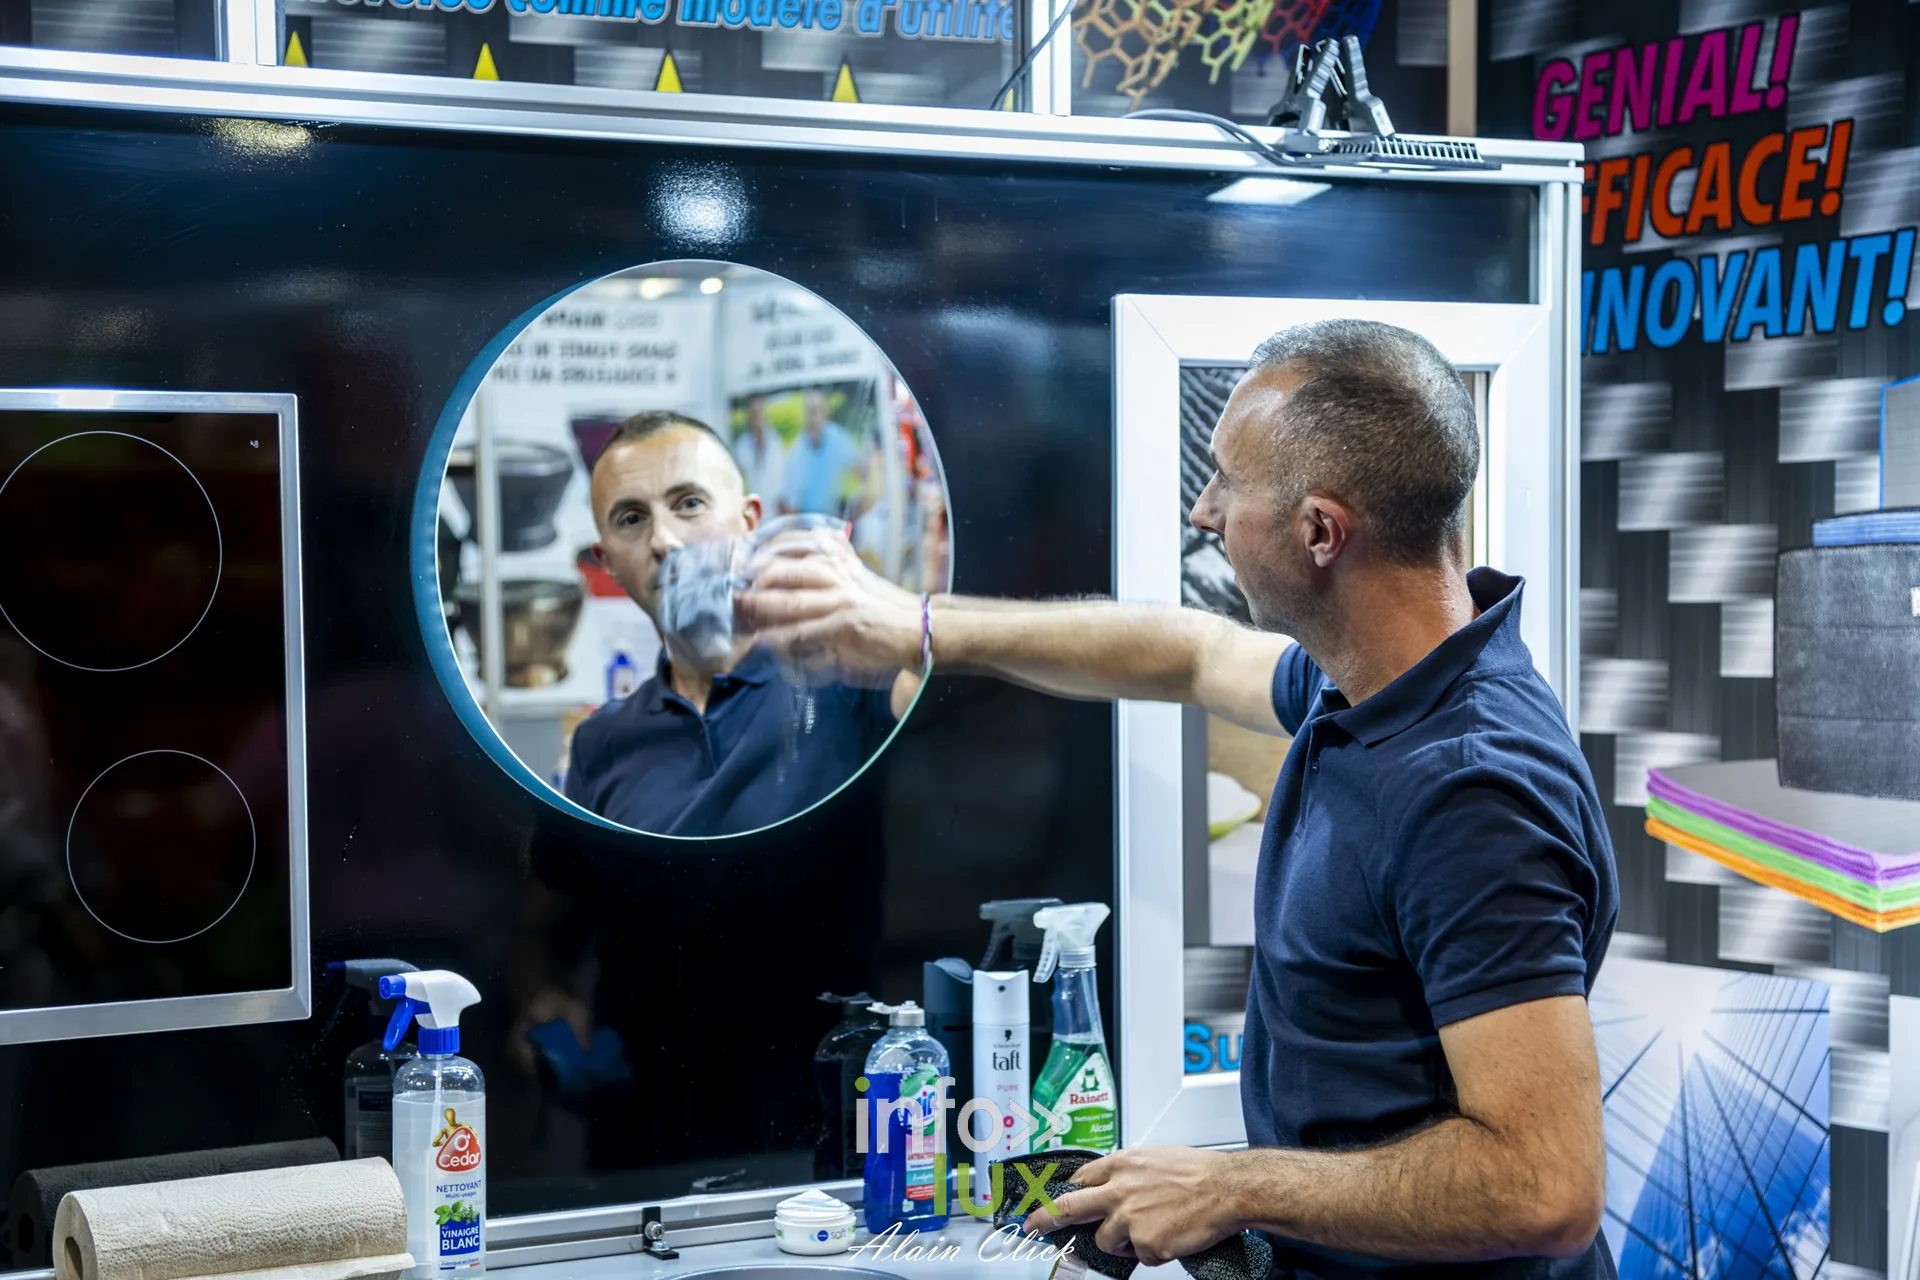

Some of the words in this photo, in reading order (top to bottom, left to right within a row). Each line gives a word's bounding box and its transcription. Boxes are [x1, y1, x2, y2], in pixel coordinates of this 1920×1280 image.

[1533, 16, 1799, 141] GENIAL!
[1582, 119, 1854, 246] FICACE!
[1581, 229, 1917, 354] NOVANT!
[993, 1049, 1022, 1071] taft
[1069, 1091, 1109, 1105] Rainett
[438, 1150, 480, 1168] Cedar
[436, 1180, 482, 1193] NETTOYANT
[442, 1226, 479, 1238] VINAIGRE
[442, 1235, 480, 1251] BLANC
